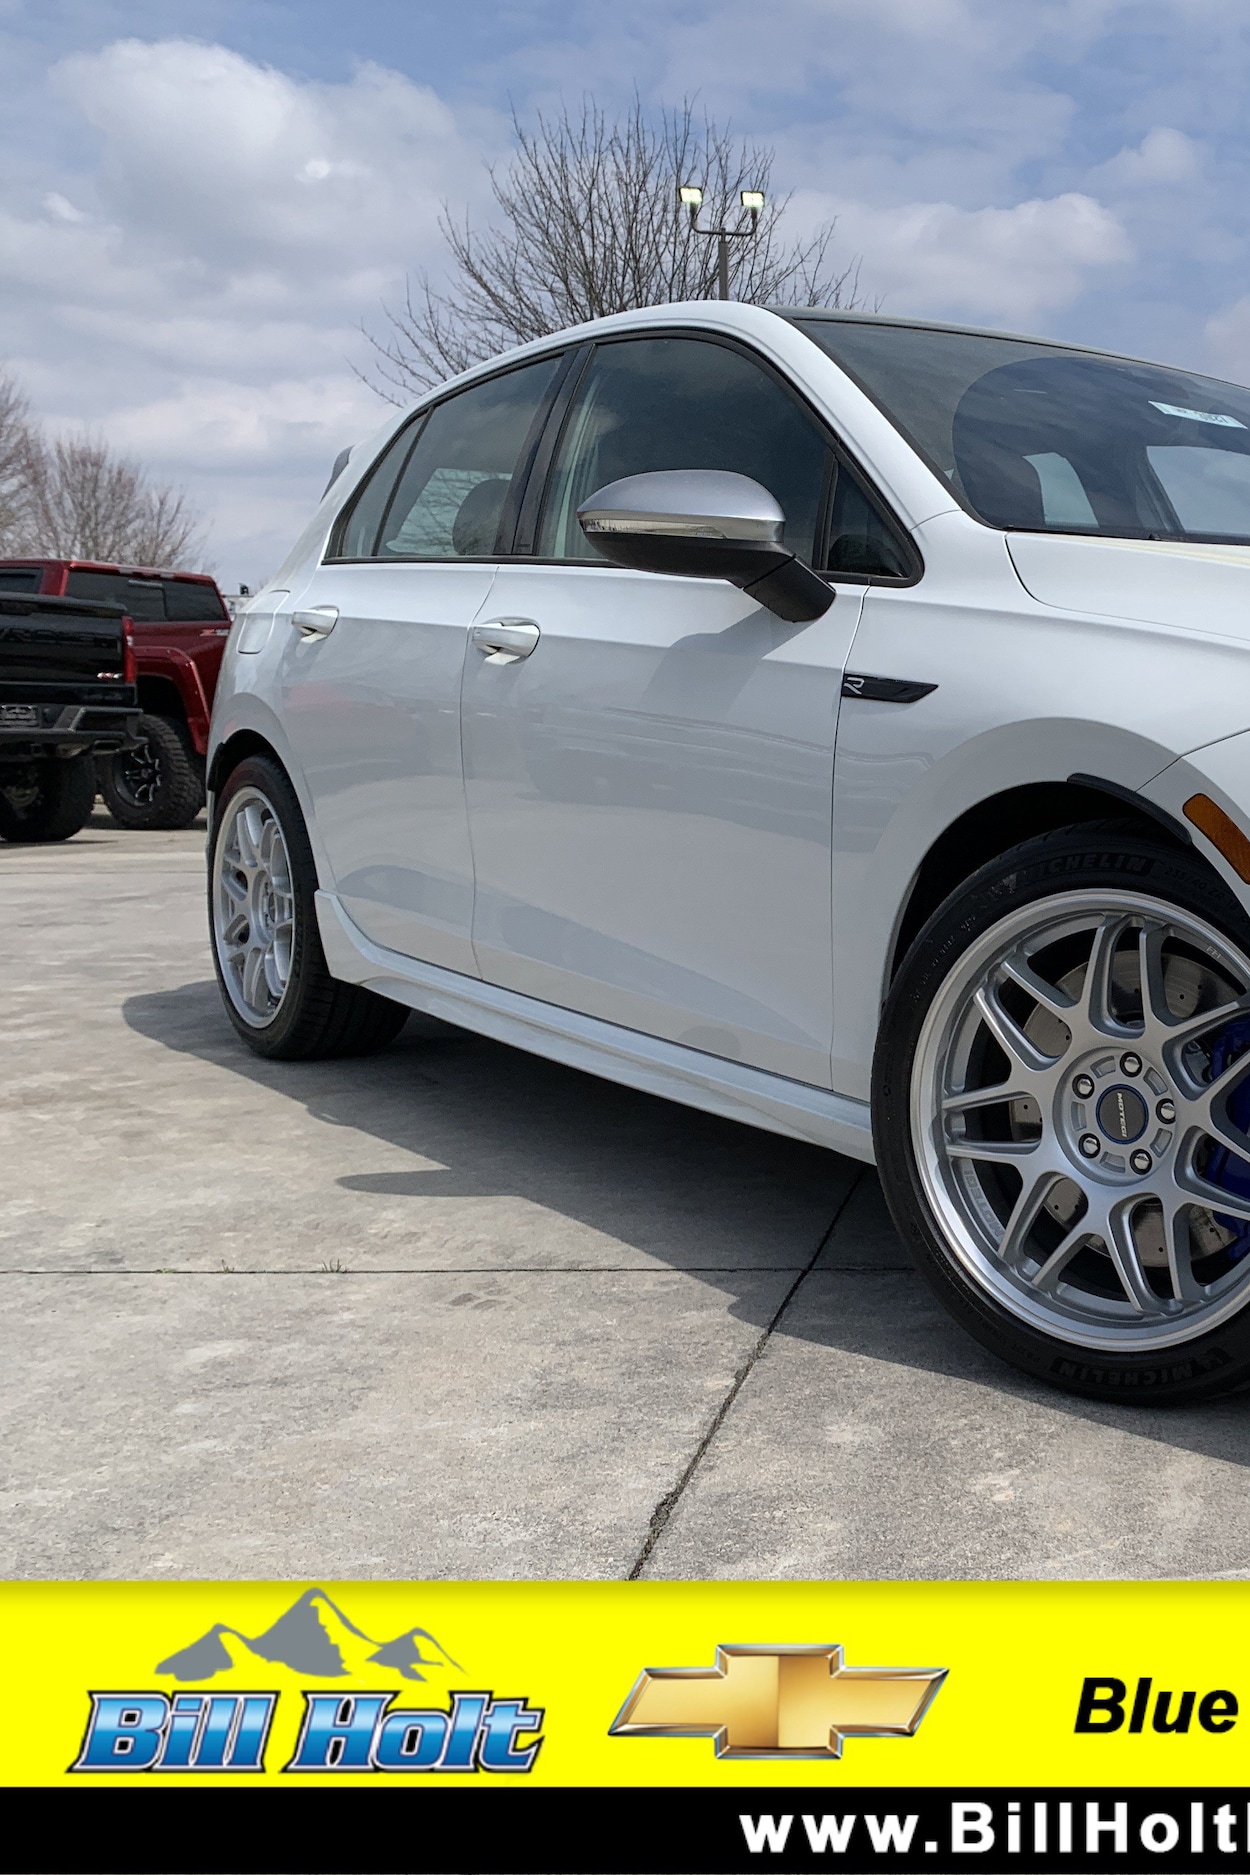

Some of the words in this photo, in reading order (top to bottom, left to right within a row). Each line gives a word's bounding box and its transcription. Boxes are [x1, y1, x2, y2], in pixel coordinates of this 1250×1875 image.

[844, 676, 865, 695] R
[1116, 1092, 1128, 1138] MOTEGI
[963, 1169, 1006, 1238] MOTEGI
[1058, 1361, 1193, 1386] MICHELIN
